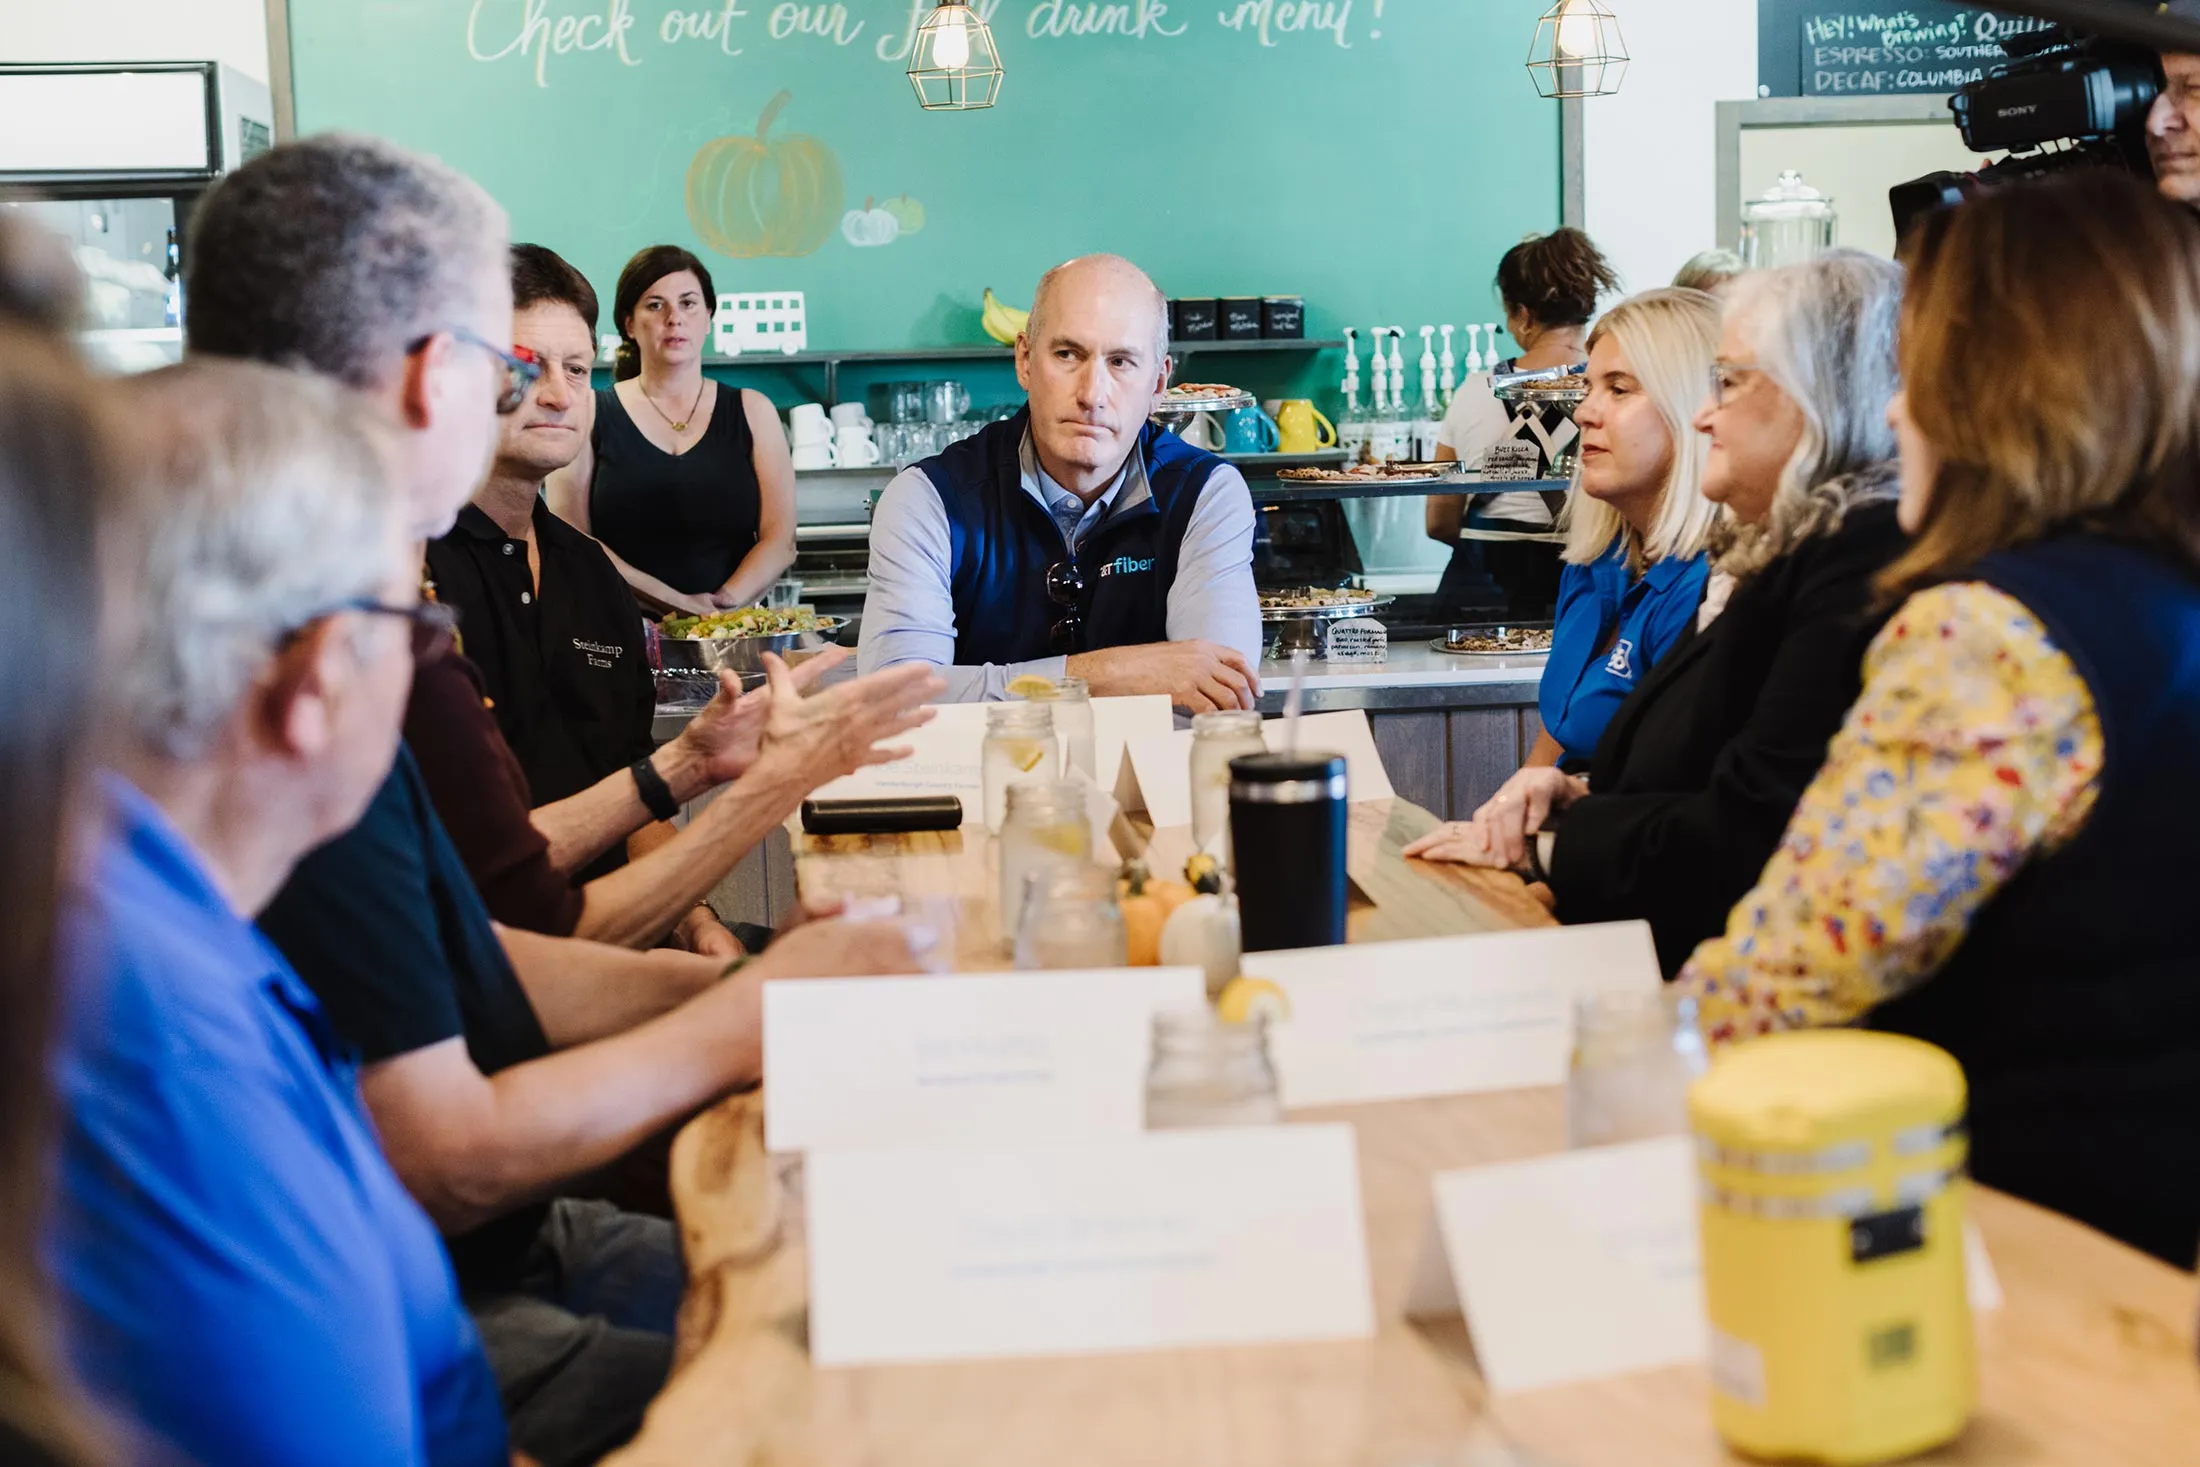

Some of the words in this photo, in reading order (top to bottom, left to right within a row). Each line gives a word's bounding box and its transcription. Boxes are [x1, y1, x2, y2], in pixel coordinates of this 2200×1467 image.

[1806, 15, 1855, 45] HEY!
[466, 0, 643, 87] Check
[659, 0, 749, 56] out
[769, 1, 866, 46] our
[1025, 0, 1188, 40] drink
[1814, 46, 1932, 66] ESPRESSO:
[1935, 44, 2008, 60] SOUTHER
[1815, 71, 1895, 91] DECAF:
[1896, 68, 1983, 87] COLUMBIA
[1998, 104, 2038, 118] SONY
[1113, 556, 1155, 574] fiber
[572, 638, 623, 658] Steinkamp
